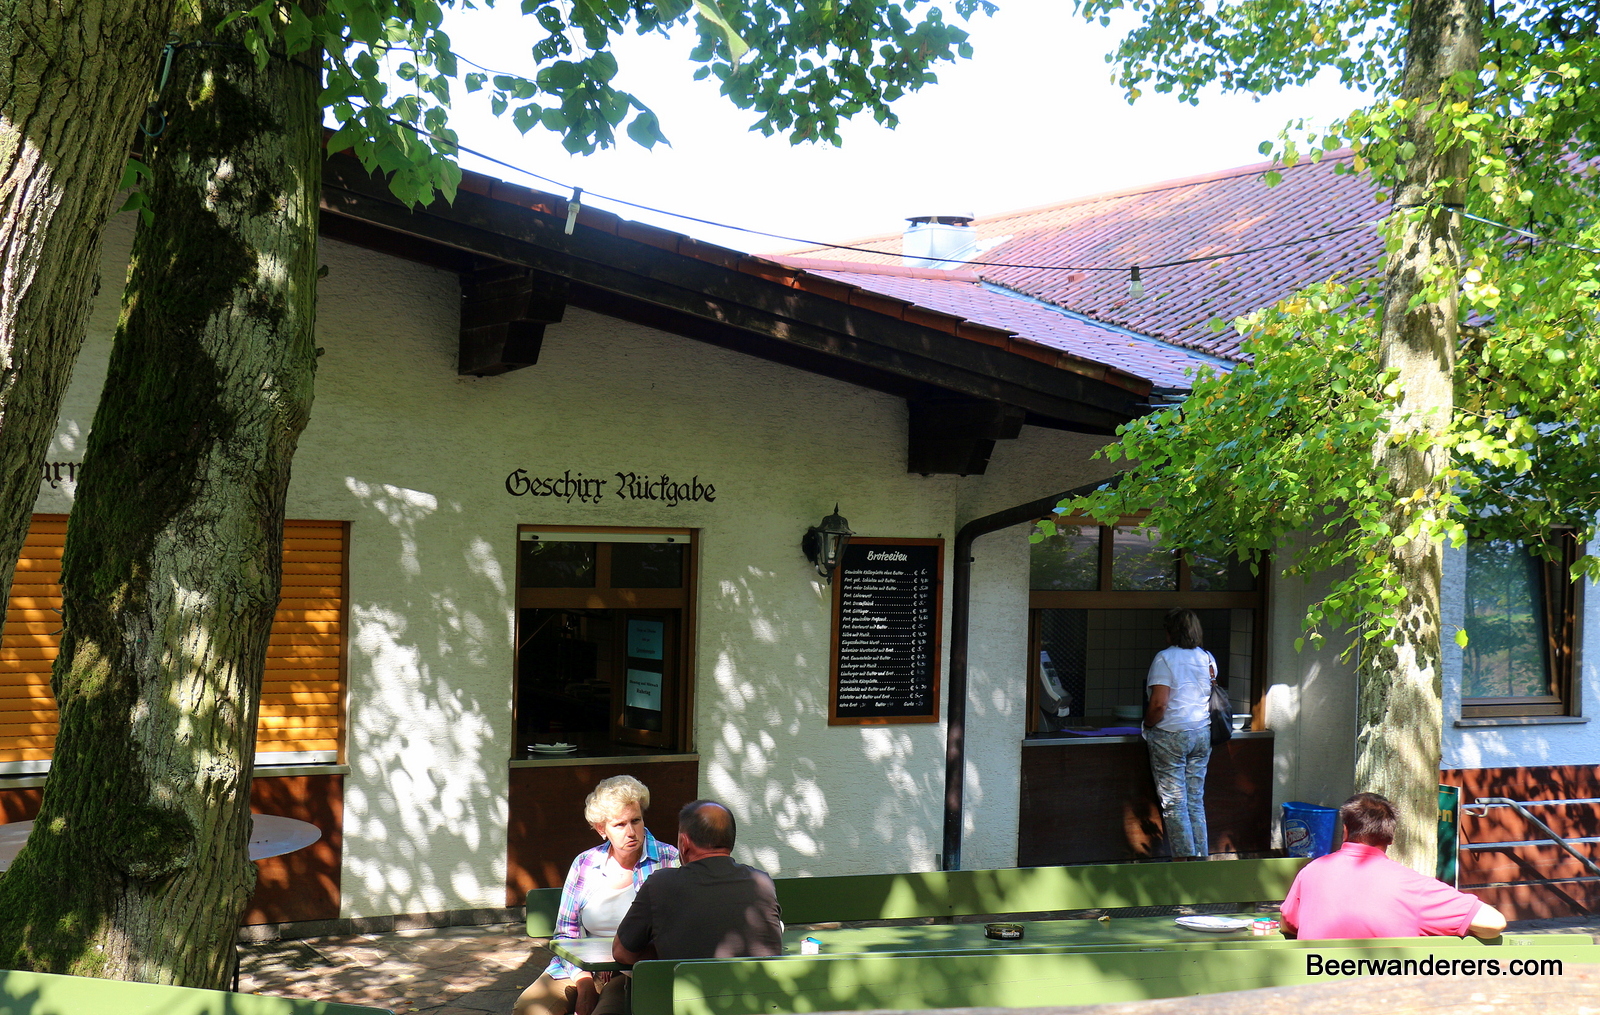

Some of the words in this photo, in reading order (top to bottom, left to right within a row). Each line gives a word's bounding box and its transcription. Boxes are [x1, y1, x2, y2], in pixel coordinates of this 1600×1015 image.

[505, 468, 607, 504] Geschirr
[615, 472, 716, 507] Rückgabe
[867, 550, 908, 562] Brotzeiten
